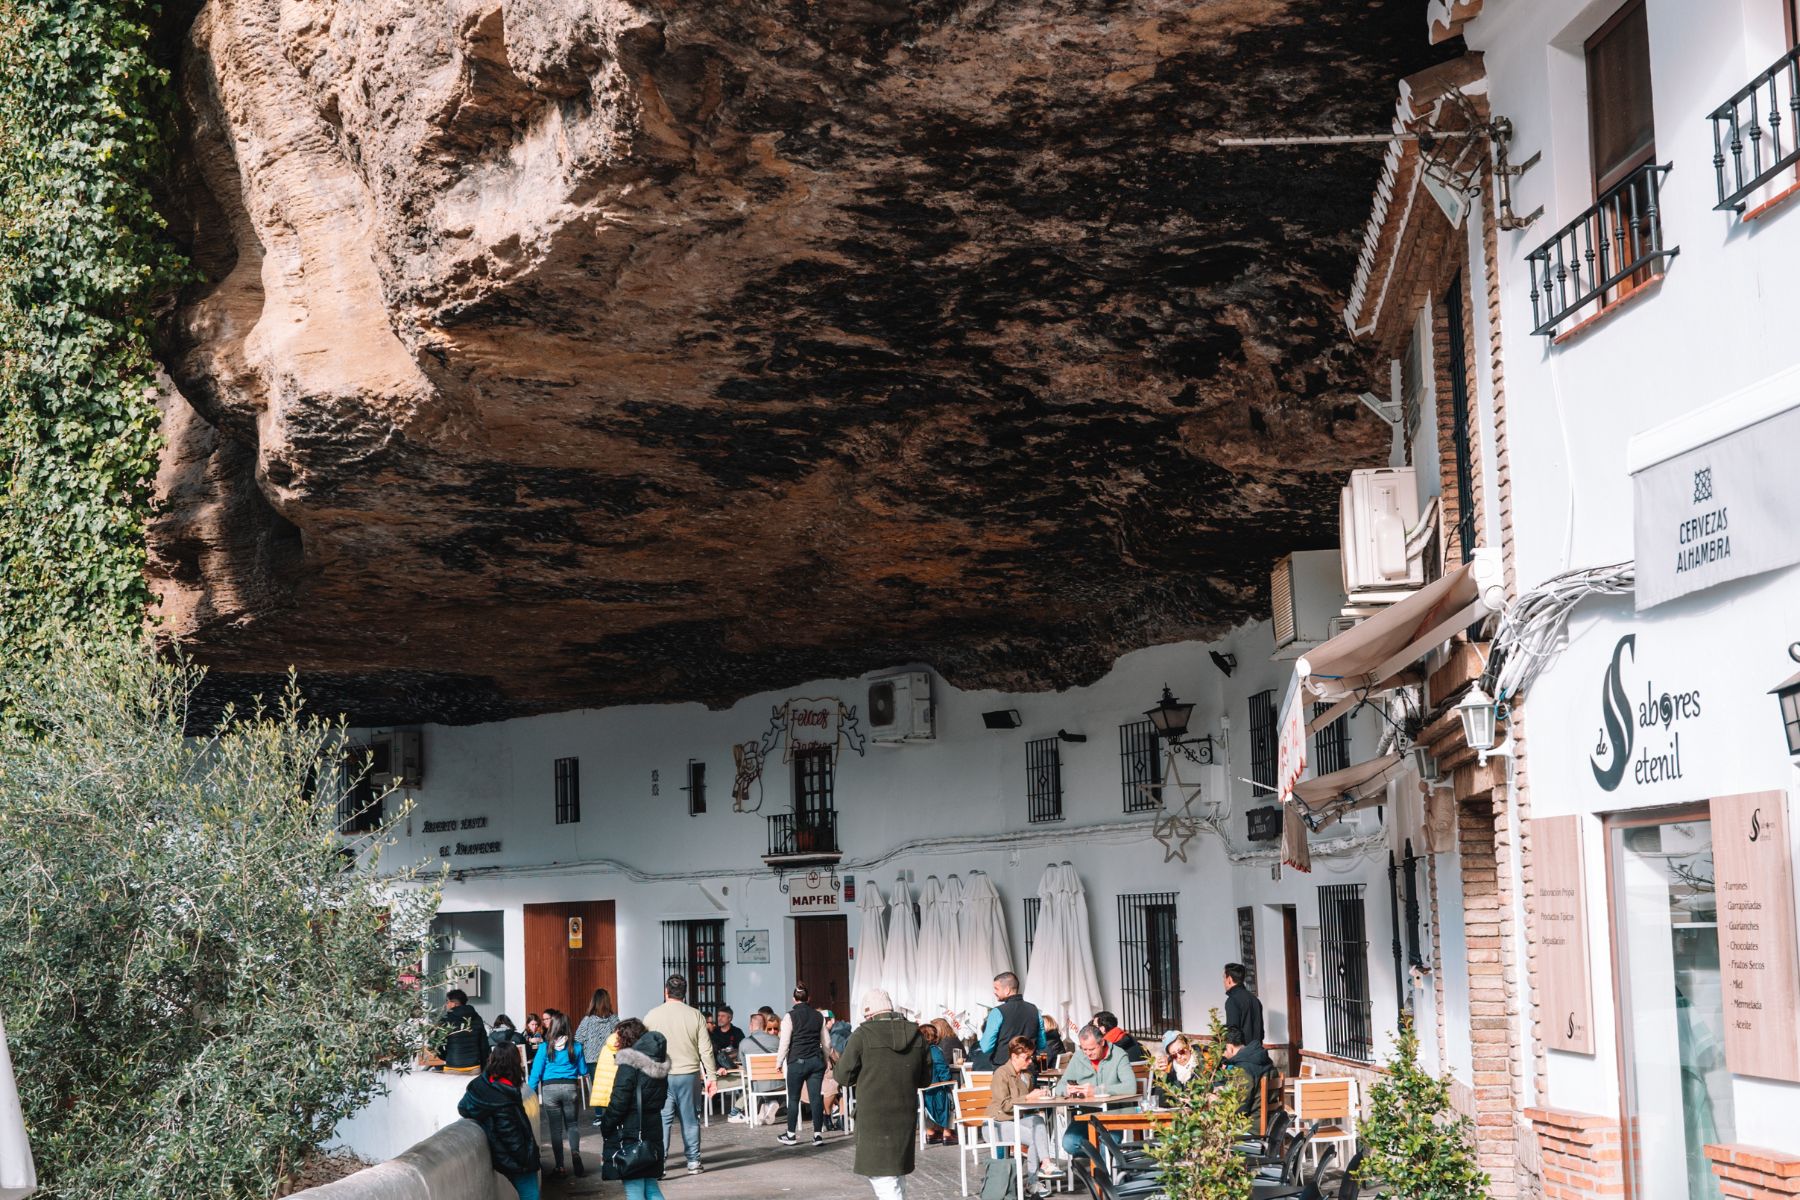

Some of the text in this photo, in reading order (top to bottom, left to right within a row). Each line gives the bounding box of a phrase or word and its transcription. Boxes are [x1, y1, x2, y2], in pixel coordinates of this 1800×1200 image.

[1679, 506, 1728, 545] CERVEZAS
[1676, 536, 1731, 574] ALHAMBRA
[1595, 728, 1607, 755] de
[792, 894, 837, 906] MAPFRE
